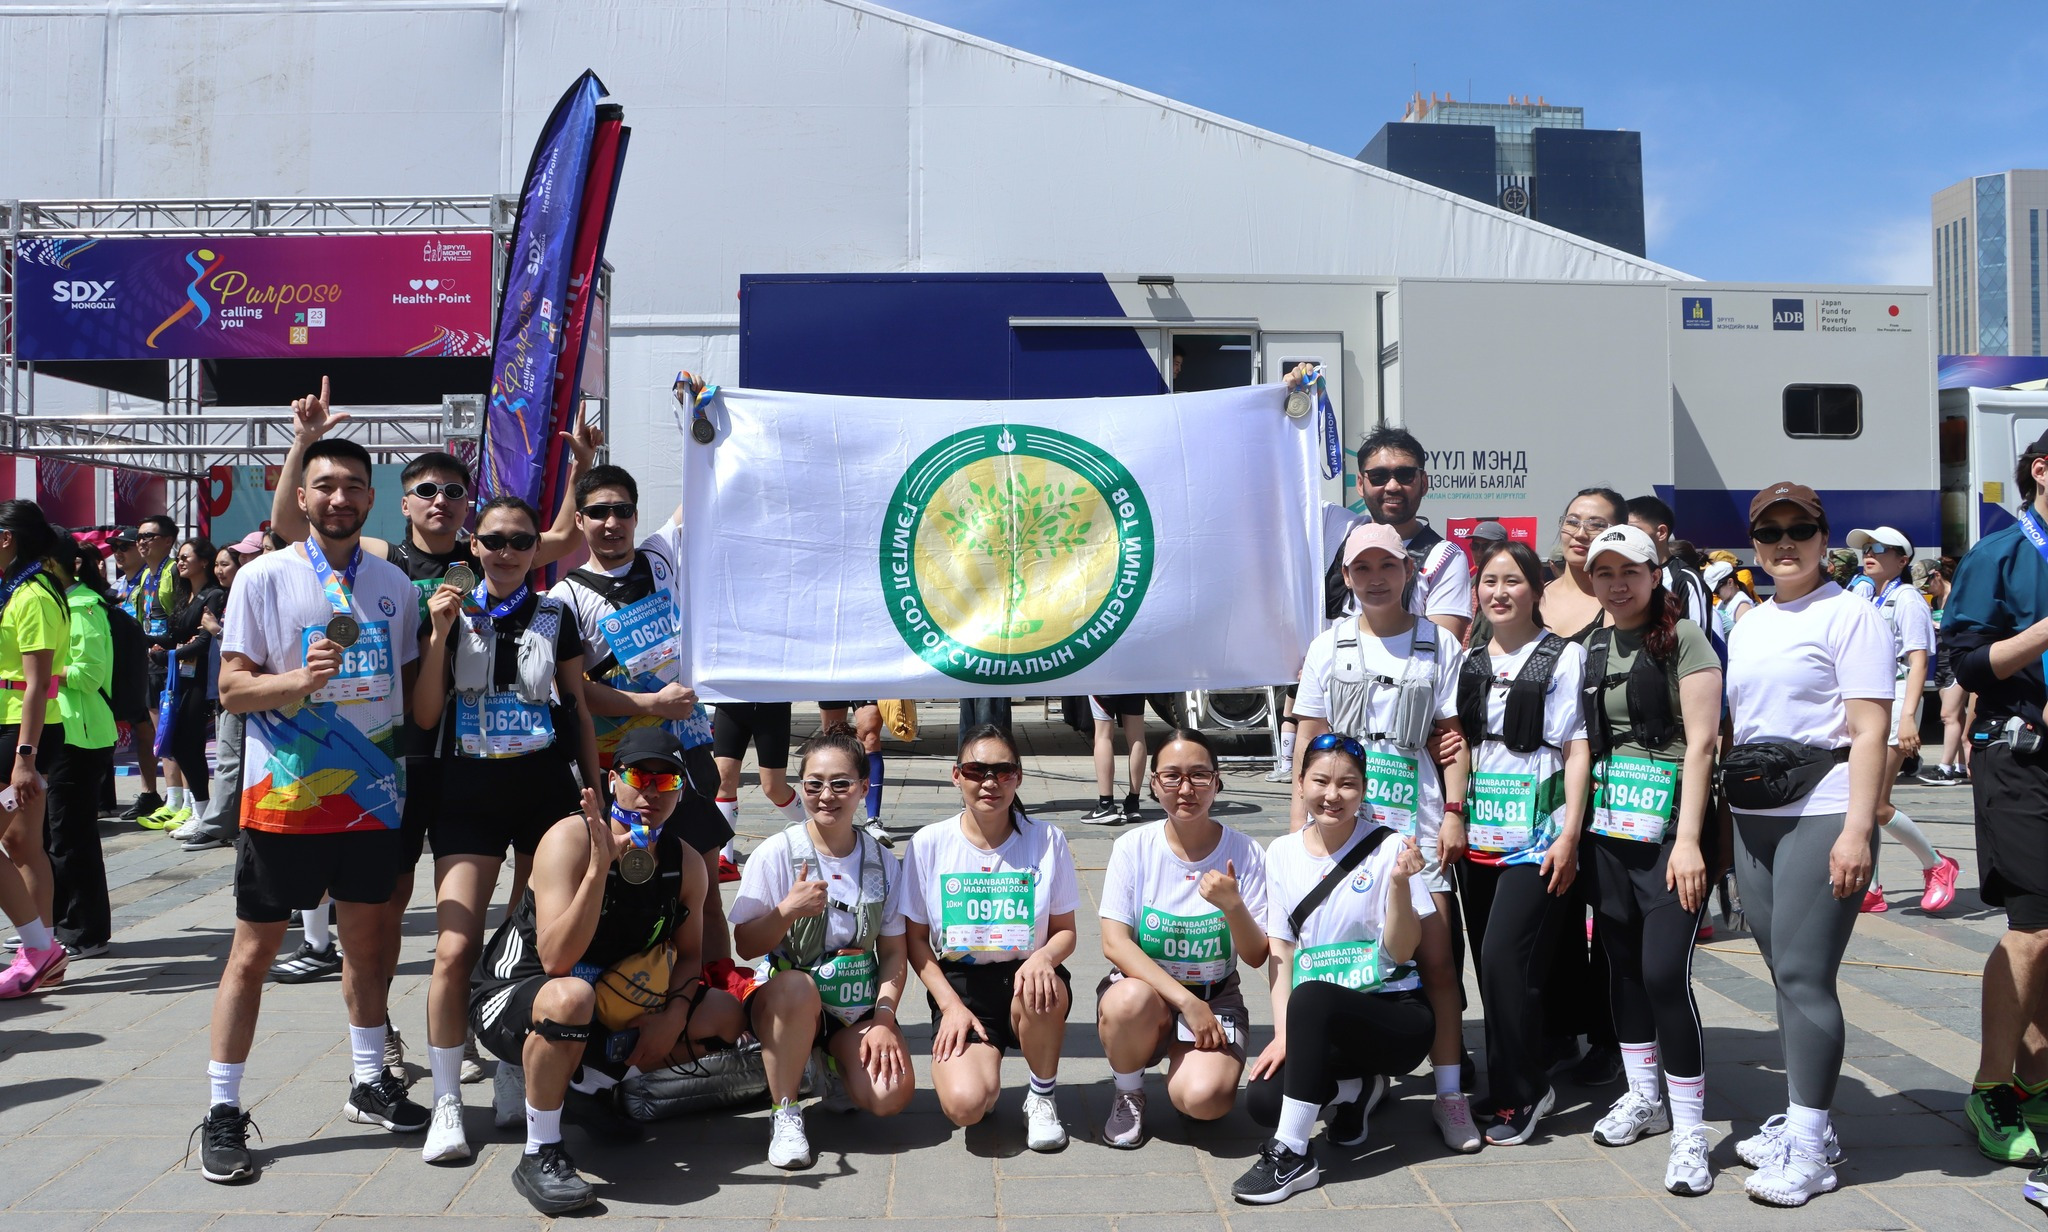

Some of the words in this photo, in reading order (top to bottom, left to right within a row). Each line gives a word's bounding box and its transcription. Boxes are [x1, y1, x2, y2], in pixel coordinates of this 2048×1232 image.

[209, 270, 342, 314] Purpose
[1821, 299, 1842, 307] Japan
[220, 306, 263, 320] calling
[310, 310, 324, 320] 23
[1773, 311, 1804, 324] ADB
[220, 319, 244, 331] you
[1821, 317, 1848, 325] Poverty
[1821, 325, 1857, 333] Reduction
[504, 290, 532, 393] Purpose
[523, 356, 534, 391] calling
[1327, 412, 1338, 465] MARATHON
[1423, 450, 1465, 471] РҮҮЛ
[1472, 450, 1528, 474] МЭНД
[1427, 472, 1477, 491] ДЭСНИЙ
[1480, 474, 1528, 489] БАЯЛАГ
[1775, 486, 1789, 494] alo
[2021, 514, 2047, 546] ATHON
[892, 501, 919, 590] ГЭМТЭЛ
[948, 645, 1076, 677] СУДЛАЛЫН
[1075, 535, 1143, 650] ҮНДЭСНИЙ
[1111, 487, 1139, 532] ТӨВ
[619, 596, 664, 620] ULAANBAATAR
[623, 607, 657, 627] MARATHON
[360, 627, 382, 636] AATAR
[373, 634, 388, 643] 2026
[613, 635, 630, 647] 21KM
[339, 648, 388, 674] 6205
[484, 709, 545, 732] 06202
[1366, 756, 1408, 771] AANBAATAR
[1608, 761, 1662, 775] LAANBAATAR
[1366, 764, 1398, 776] RATHON
[1398, 770, 1415, 779] 2026
[1648, 774, 1671, 784] 2026
[1366, 778, 1414, 806] 9482
[1509, 787, 1530, 795] 2026
[1475, 799, 1527, 822] 09481
[963, 877, 1020, 886] ULAANBAATAR
[963, 885, 1008, 894] MARATHON
[1009, 885, 1029, 893] 2026
[945, 900, 963, 909] 10KM
[966, 898, 1029, 920] 09764
[1161, 917, 1218, 928] ULAANBAATAR
[1161, 925, 1208, 935] MARATHON
[1208, 923, 1226, 933] 2026
[1143, 933, 1160, 944] 10KM
[1164, 936, 1223, 959] 09471
[1311, 946, 1363, 960] ULAANBAATAR
[1313, 955, 1352, 968] MARATHON
[1352, 953, 1373, 964] 2026
[819, 984, 836, 992] 10KM
